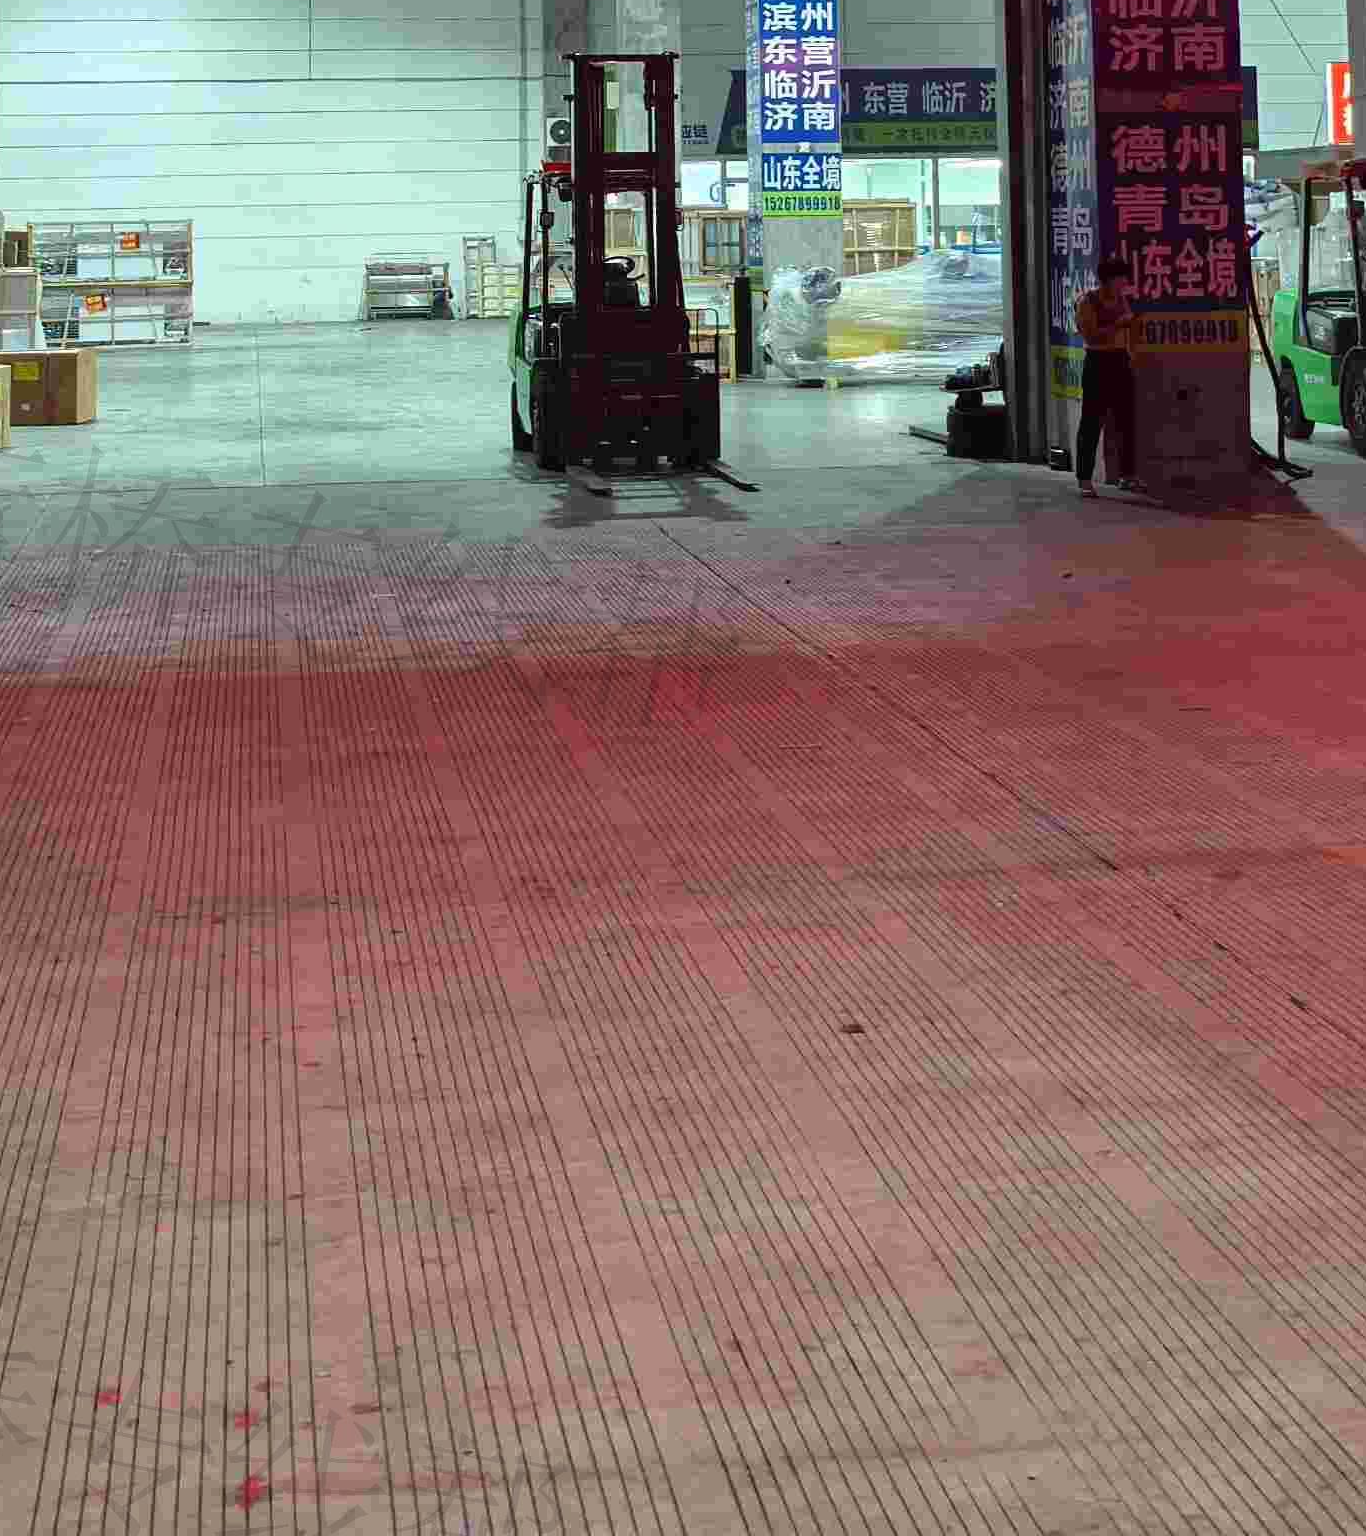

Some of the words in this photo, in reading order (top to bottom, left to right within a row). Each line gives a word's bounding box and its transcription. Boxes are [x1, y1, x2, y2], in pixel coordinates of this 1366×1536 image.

[762, 3, 835, 32] 滨州
[763, 36, 836, 66] 东营
[1109, 25, 1227, 72] 济南
[764, 69, 836, 99] 临沂
[862, 81, 908, 114] 东营
[921, 81, 968, 114] 临沂
[764, 103, 836, 132] 济南
[1111, 124, 1227, 176] 德州
[764, 155, 841, 190] 山东全境
[1112, 182, 1229, 233] 青岛
